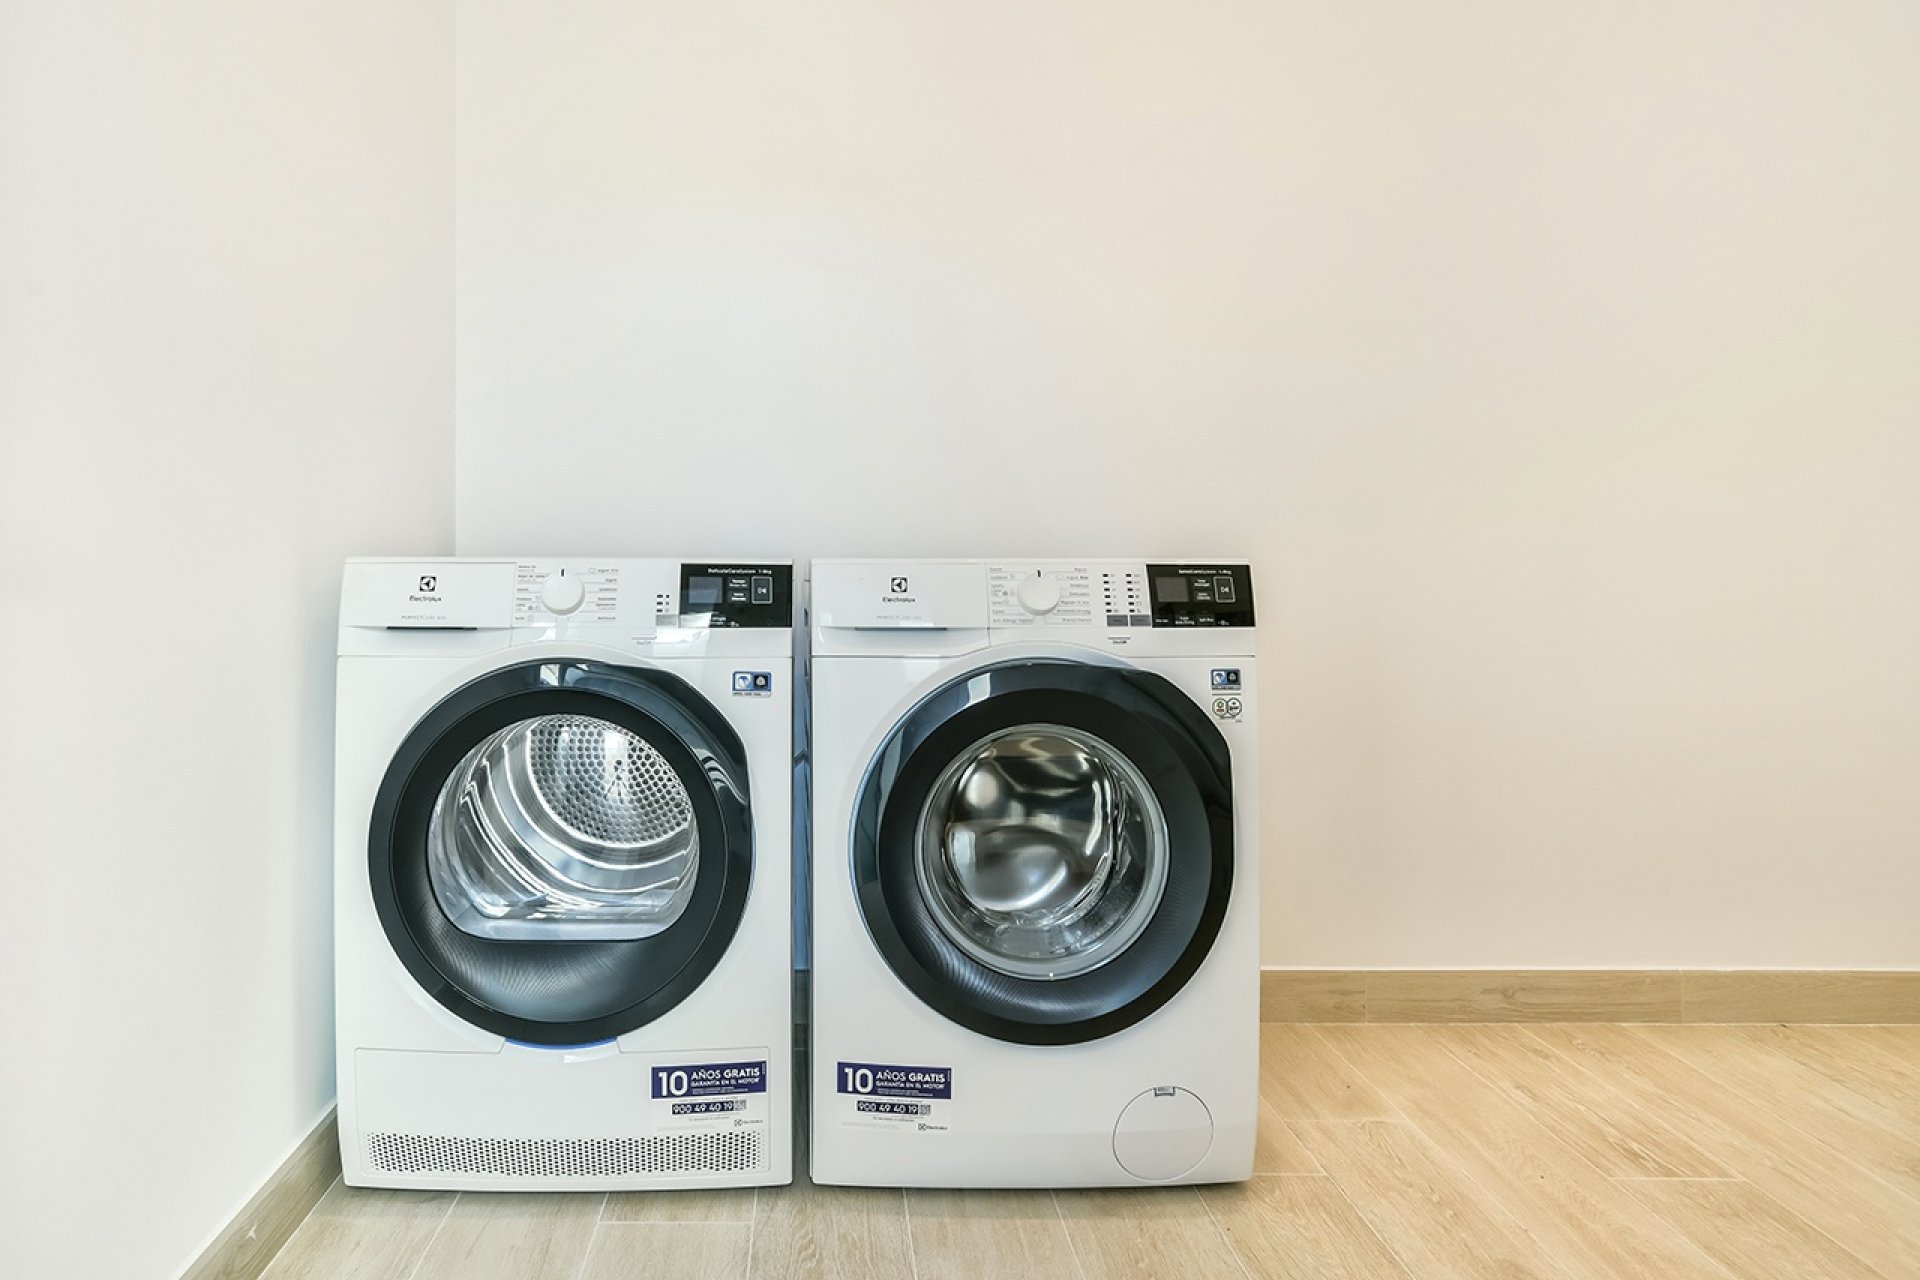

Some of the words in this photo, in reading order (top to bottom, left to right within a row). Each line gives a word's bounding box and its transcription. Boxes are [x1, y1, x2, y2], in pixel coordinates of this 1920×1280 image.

[691, 1068, 721, 1080] AÑOS
[723, 1067, 760, 1079] GRATIS
[844, 1067, 874, 1093] 10
[876, 1069, 906, 1081] AÑOS
[908, 1072, 945, 1083] GRATIS
[658, 1071, 688, 1096] 10
[690, 1079, 720, 1087] GARANTÍA
[673, 1104, 692, 1114] 900
[694, 1103, 707, 1112] 49
[709, 1103, 722, 1112] 40
[724, 1102, 733, 1111] 19
[860, 1102, 876, 1111] 900
[879, 1103, 891, 1112] 49
[894, 1104, 906, 1113] 40
[908, 1105, 918, 1114] 19
